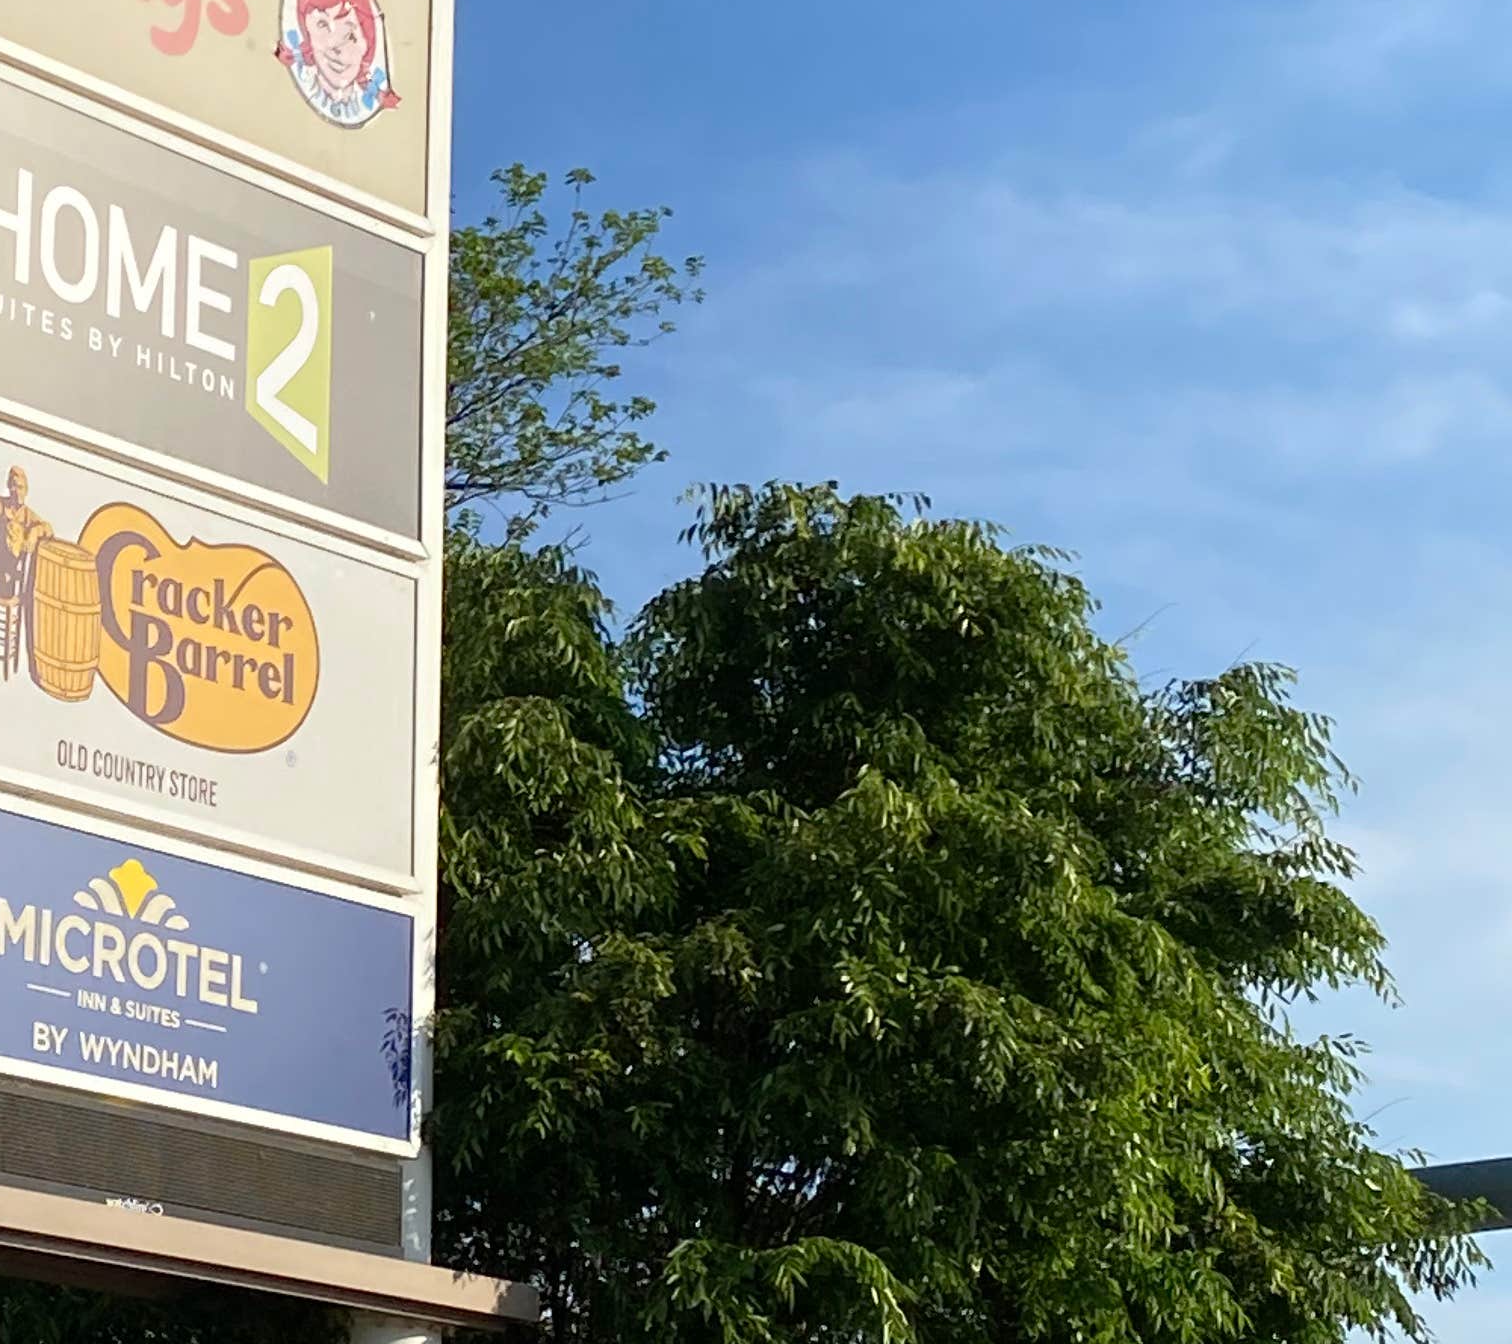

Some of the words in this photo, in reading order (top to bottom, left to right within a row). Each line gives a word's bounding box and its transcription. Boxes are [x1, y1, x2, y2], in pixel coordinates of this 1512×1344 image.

[87, 326, 124, 358] BY
[136, 342, 236, 402] HILTON
[255, 263, 320, 456] 2
[95, 530, 294, 653] Cracker
[125, 610, 296, 726] Barrel
[57, 739, 88, 772] OLD
[92, 748, 167, 794] COUNTRY
[169, 769, 219, 808] STORE
[76, 989, 107, 1014] INN
[109, 997, 123, 1017] &
[124, 1000, 182, 1029] SUITES
[32, 1021, 70, 1056] BY
[79, 1031, 219, 1090] WYNDHAM
